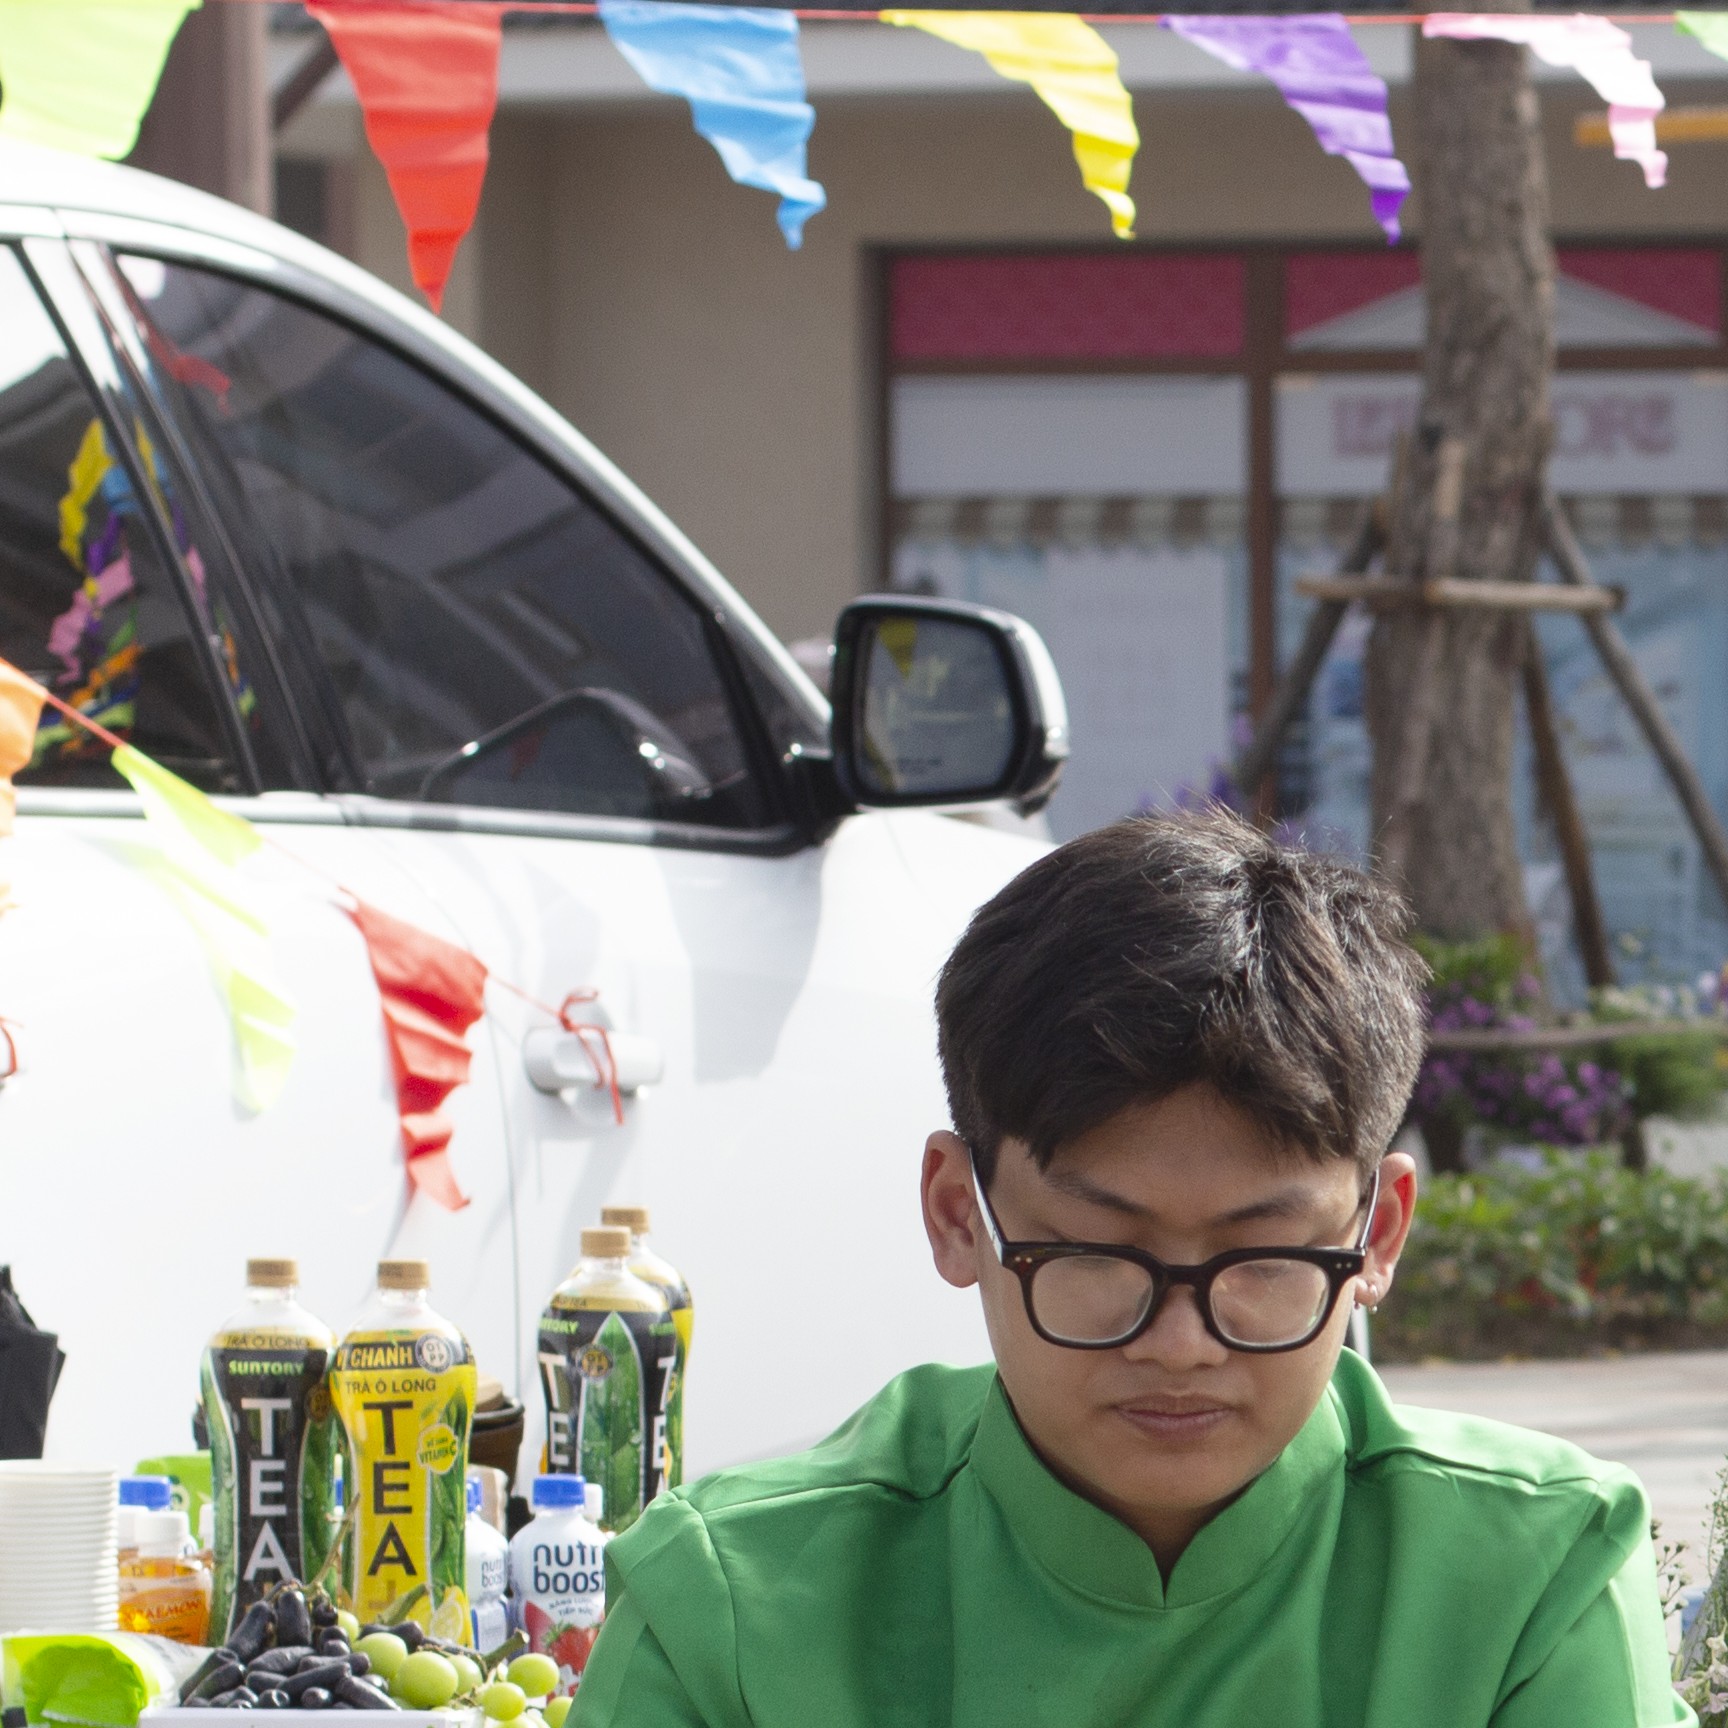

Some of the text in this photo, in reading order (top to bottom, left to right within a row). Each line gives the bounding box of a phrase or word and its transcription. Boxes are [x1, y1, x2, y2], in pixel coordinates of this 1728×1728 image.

[350, 1346, 413, 1368] CHANH
[345, 1377, 371, 1394] TRÀ
[391, 1376, 437, 1393] LONG
[241, 1397, 294, 1581] TEA
[362, 1400, 418, 1577] TEA
[533, 1541, 605, 1567] nutr
